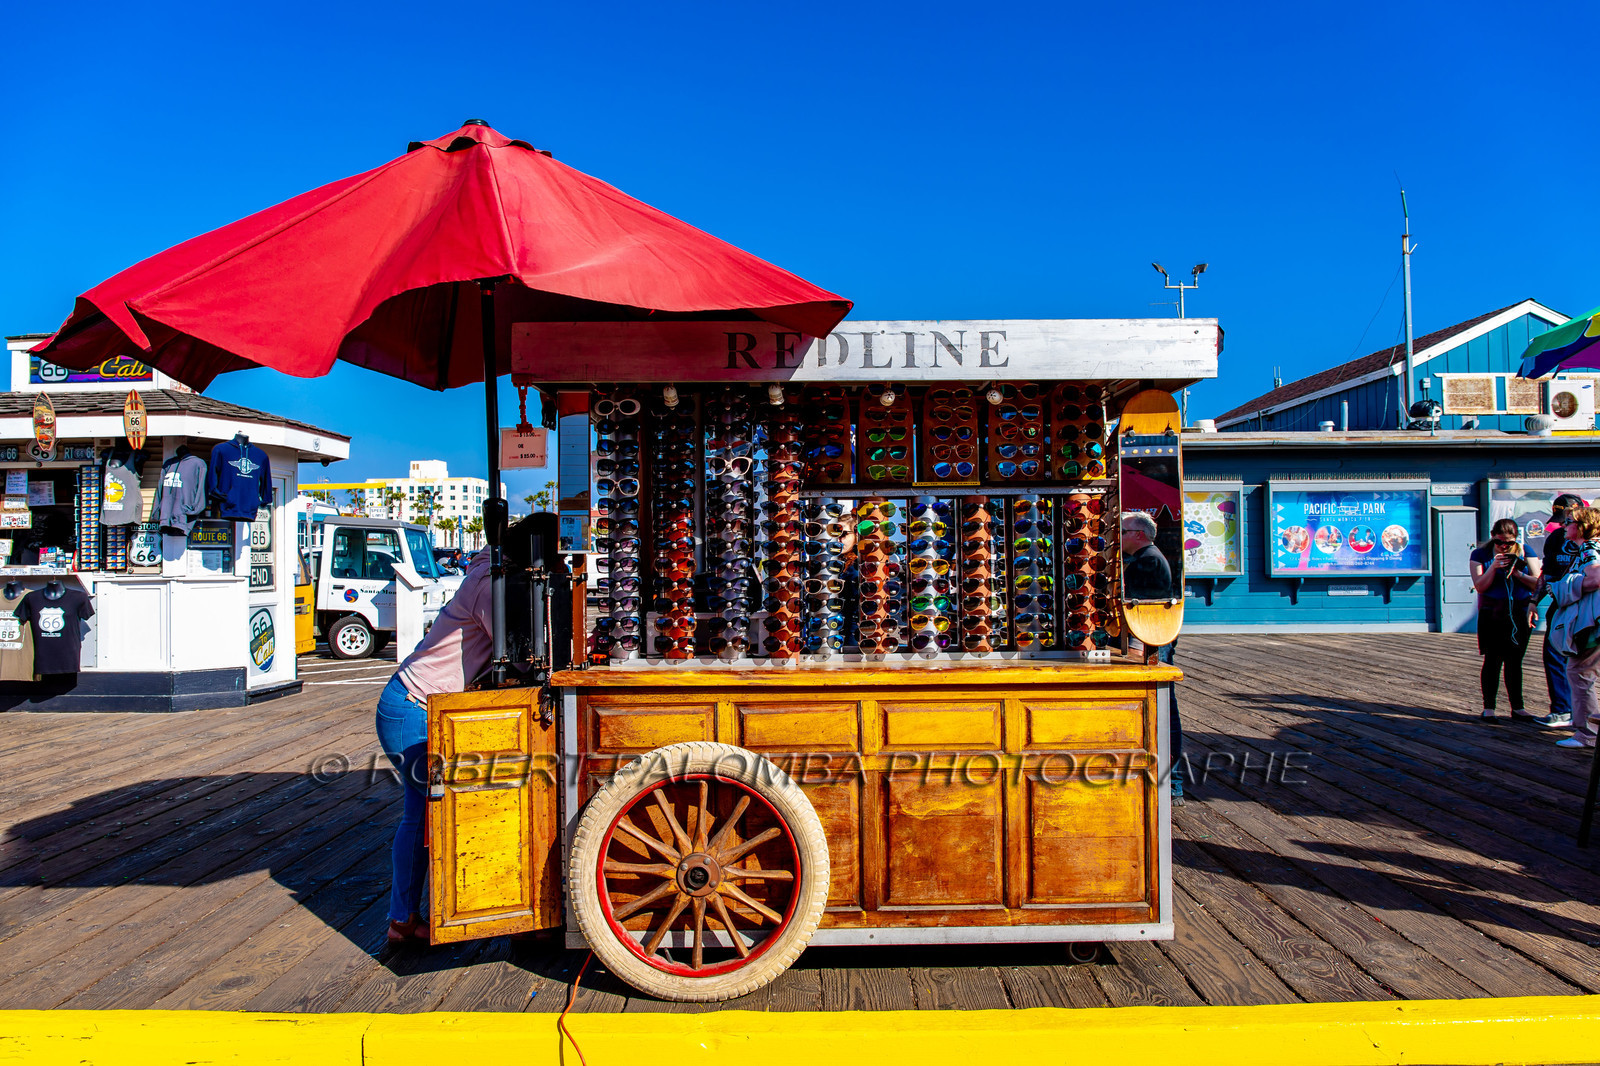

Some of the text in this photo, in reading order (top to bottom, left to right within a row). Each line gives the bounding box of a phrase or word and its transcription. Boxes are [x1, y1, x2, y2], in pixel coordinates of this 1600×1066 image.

[723, 330, 1009, 369] REDLINE
[42, 356, 147, 378] 66 Cali
[130, 417, 140, 426] 66
[6, 448, 17, 460] 66
[31, 446, 50, 458] 66
[64, 446, 74, 459] RT
[1304, 502, 1386, 514] PACIFIC PARK
[192, 532, 227, 542] ROUTE 66
[252, 530, 266, 545] 66
[136, 550, 157, 562] 66
[250, 554, 268, 562] ROUTE
[251, 568, 268, 585] END
[43, 617, 60, 628] 66
[252, 616, 268, 638] 66
[2, 630, 16, 638] 66
[259, 632, 268, 645] To
[255, 640, 274, 665] Cali
